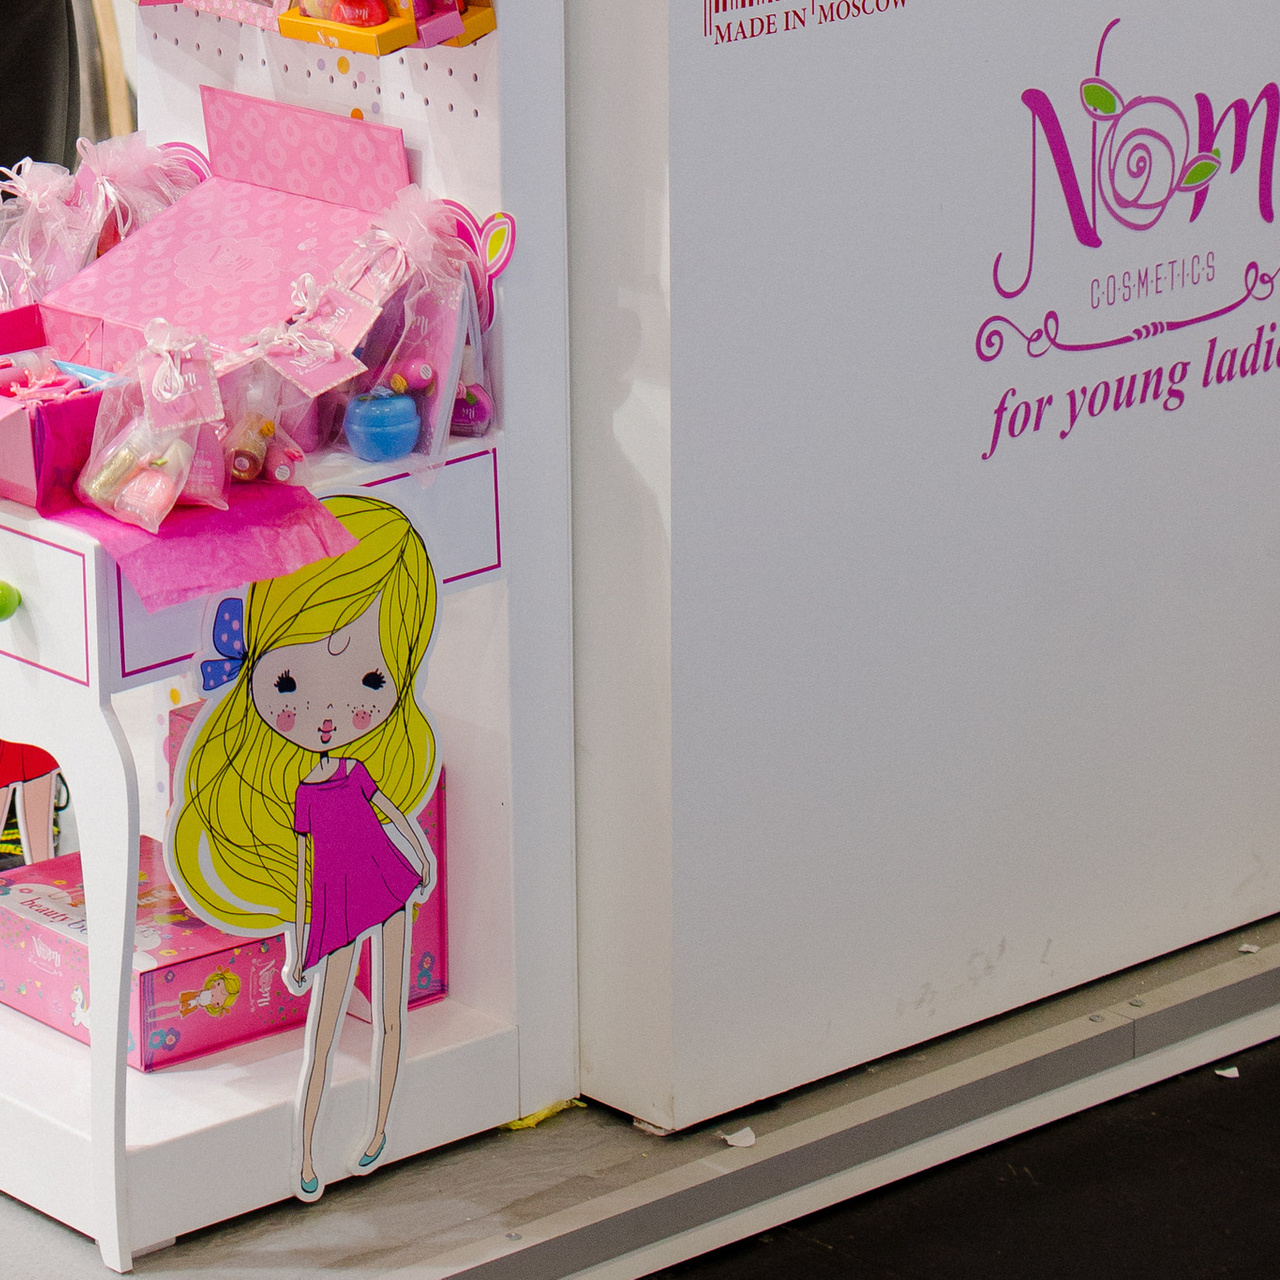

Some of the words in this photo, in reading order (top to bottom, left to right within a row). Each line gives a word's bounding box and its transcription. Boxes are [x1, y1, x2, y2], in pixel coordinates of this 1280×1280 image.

[713, 13, 778, 45] MADE
[783, 8, 808, 31] IN
[1090, 251, 1216, 309] COSMETICS
[981, 387, 1053, 460] for
[1059, 360, 1191, 440] young
[19, 896, 69, 923] beauty
